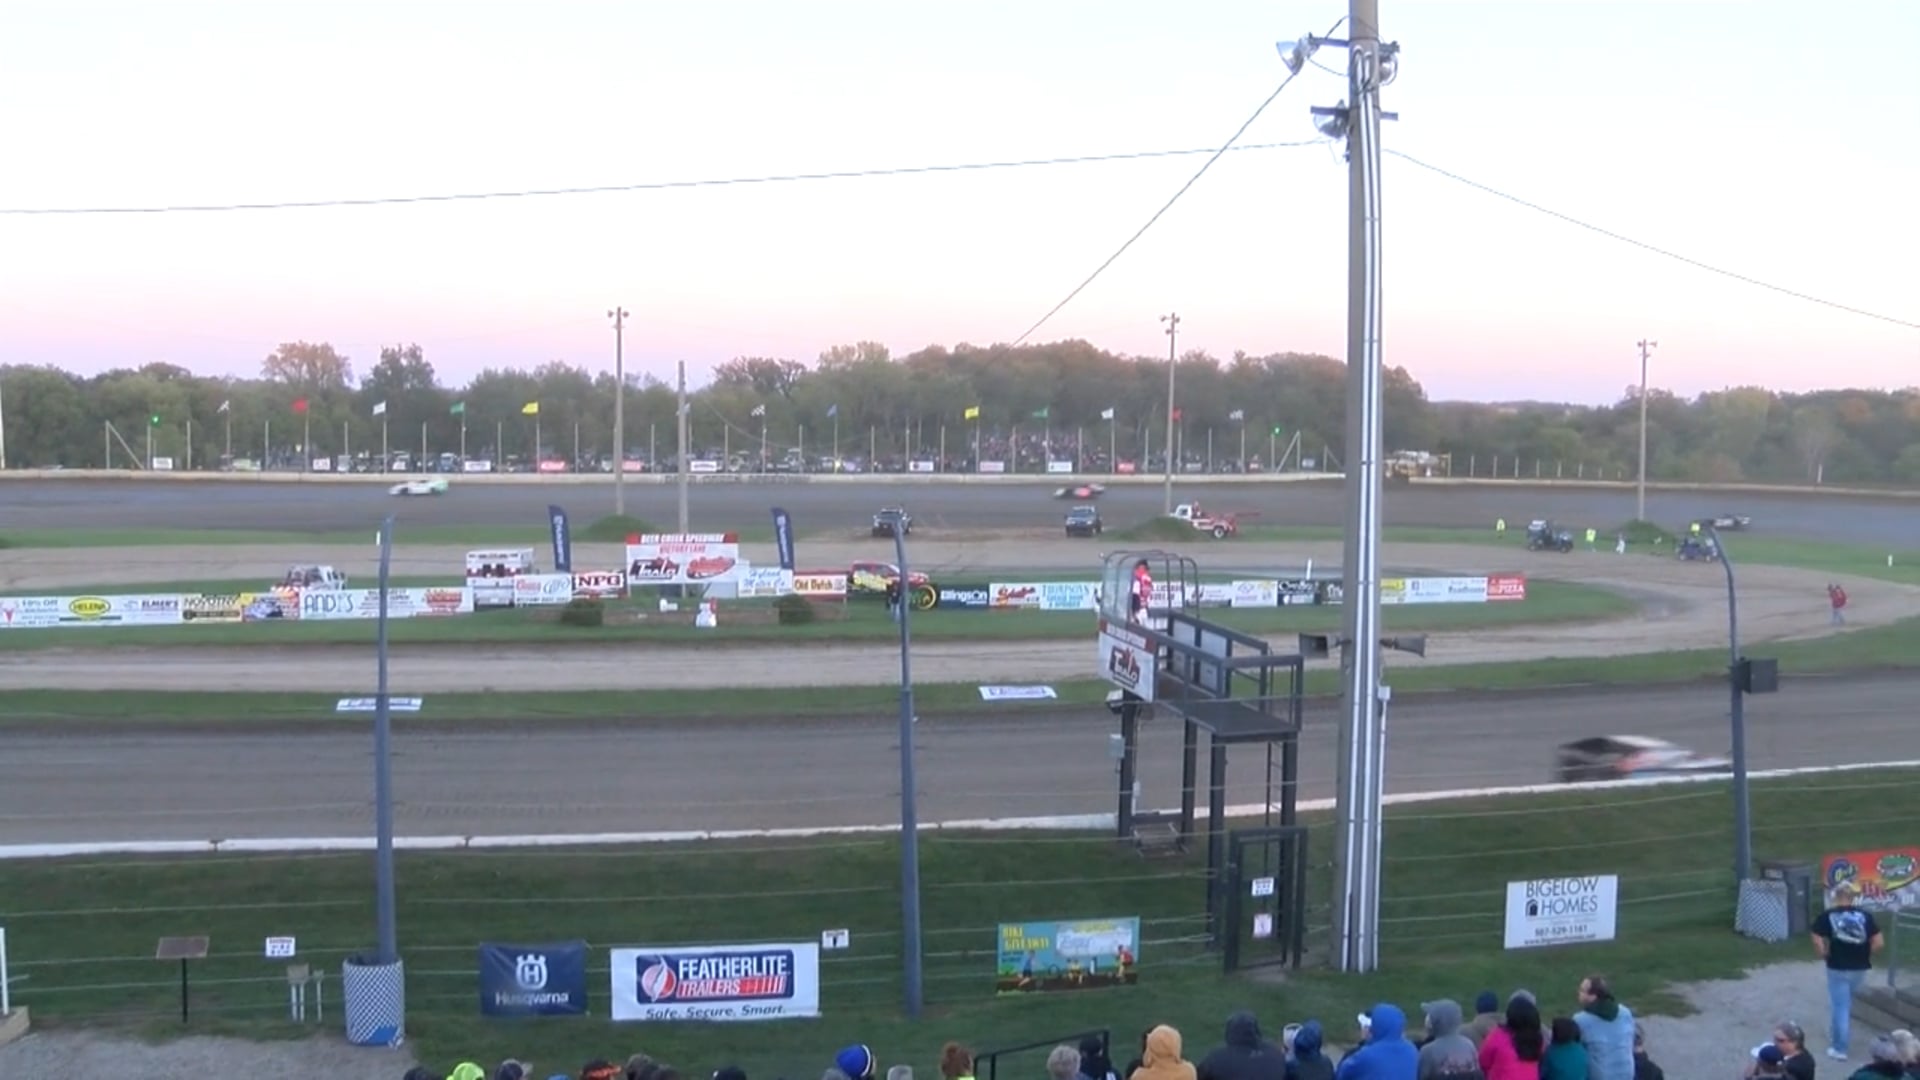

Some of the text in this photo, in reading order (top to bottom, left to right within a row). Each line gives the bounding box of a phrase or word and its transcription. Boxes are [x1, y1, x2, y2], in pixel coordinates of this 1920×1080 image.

[578, 574, 621, 587] NPG
[72, 602, 106, 611] HELENA
[1526, 877, 1599, 898] BIGELOW
[1541, 895, 1598, 916] HOMES
[678, 955, 788, 980] FEATHERLITE
[680, 979, 741, 997] TRAILERS
[495, 991, 569, 1007] Husqvarna
